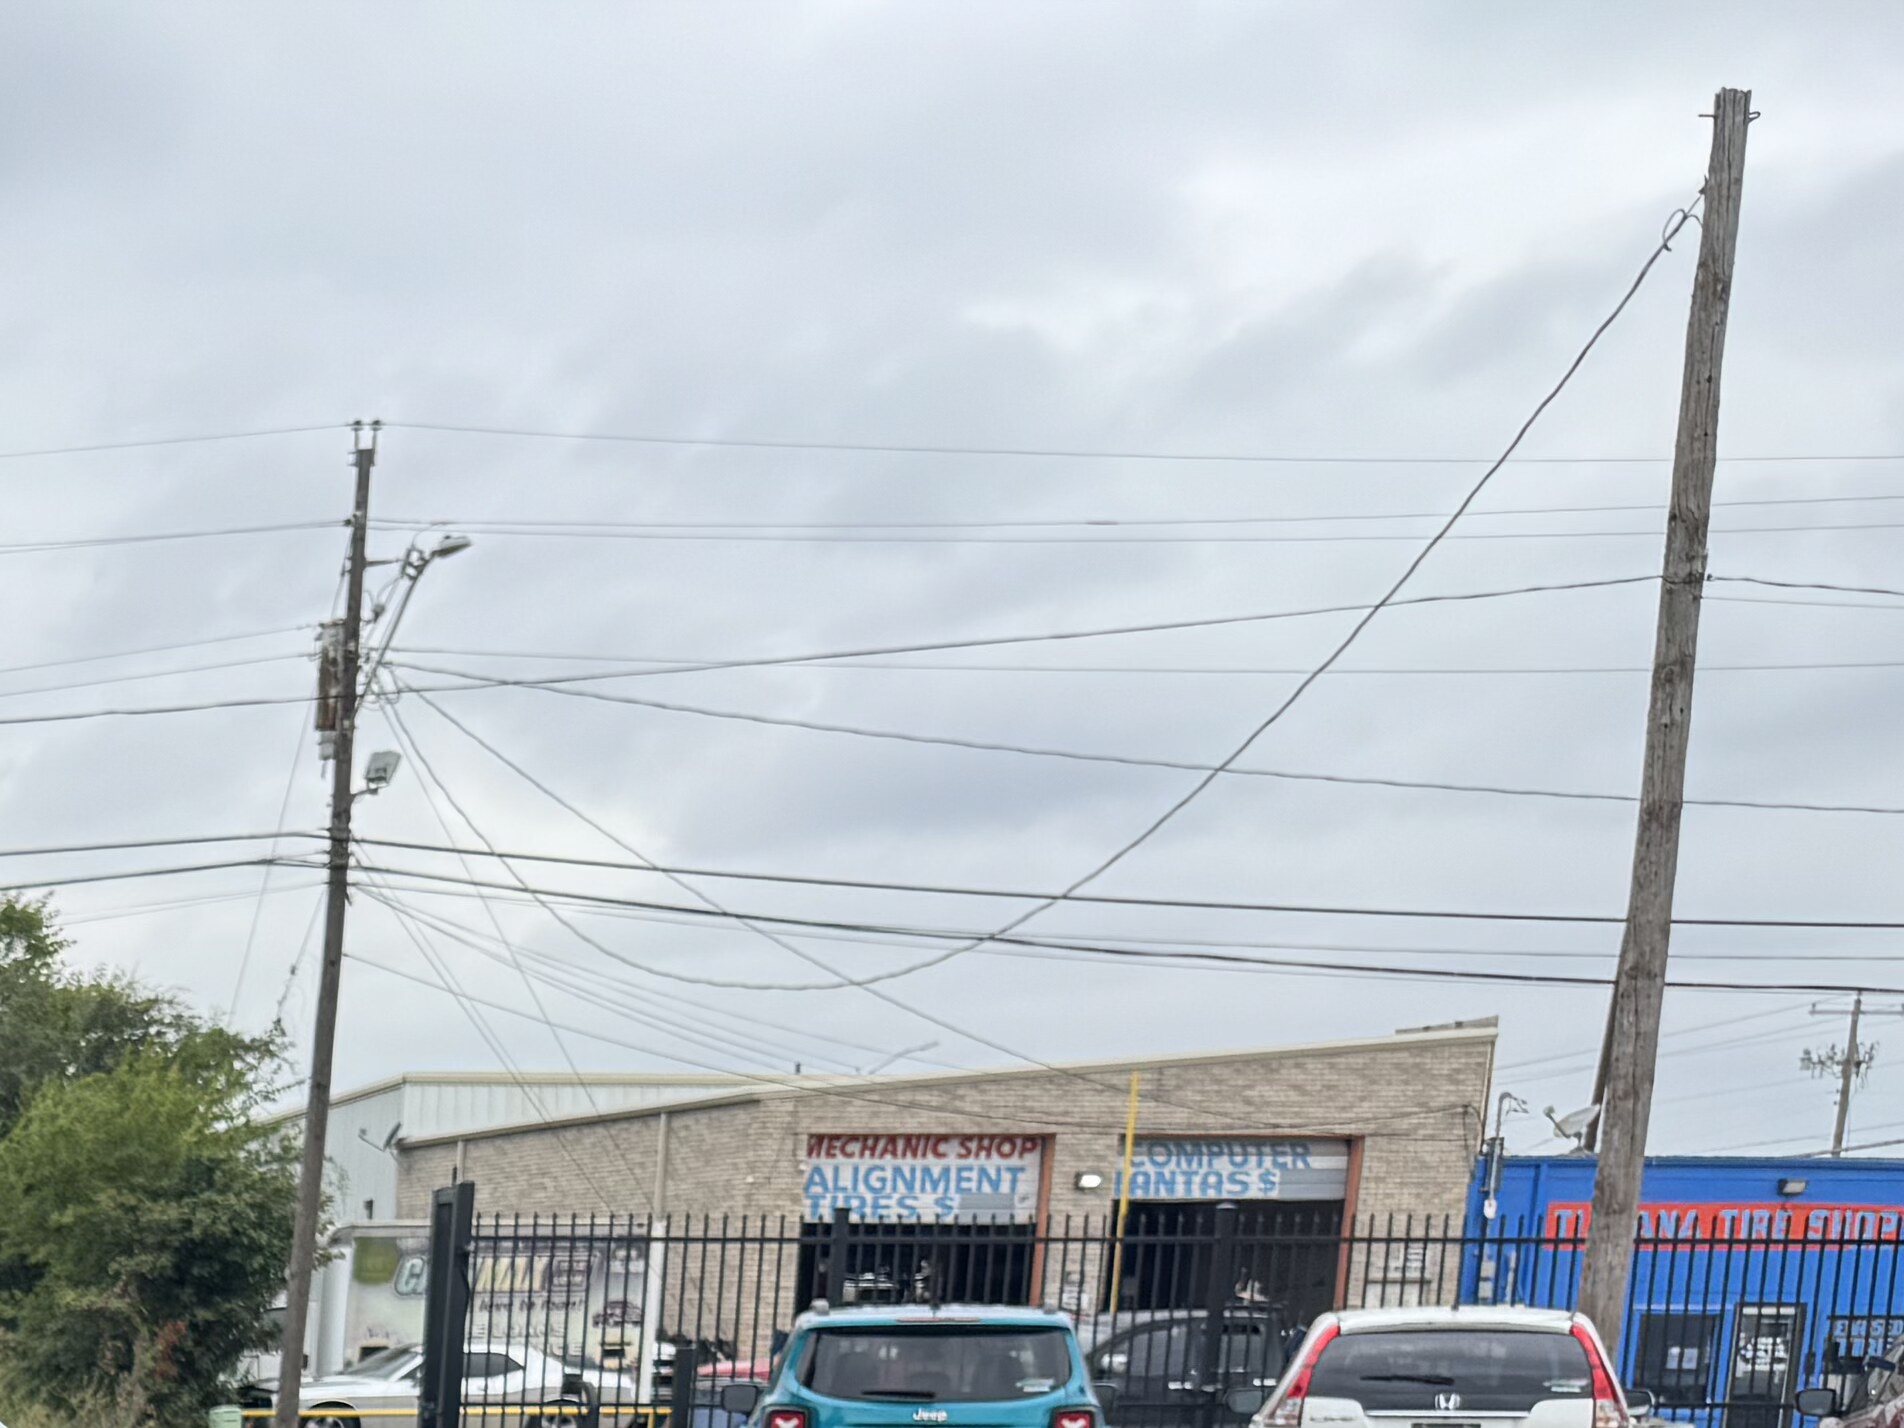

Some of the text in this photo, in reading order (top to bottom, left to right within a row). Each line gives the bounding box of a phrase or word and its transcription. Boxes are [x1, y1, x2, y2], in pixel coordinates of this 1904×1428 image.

[806, 1134, 1040, 1160] MECHANIC SHOP
[803, 1164, 1027, 1195] ALIGNMENT
[1719, 1209, 1793, 1241] TIRE
[1807, 1209, 1900, 1242] SHOP
